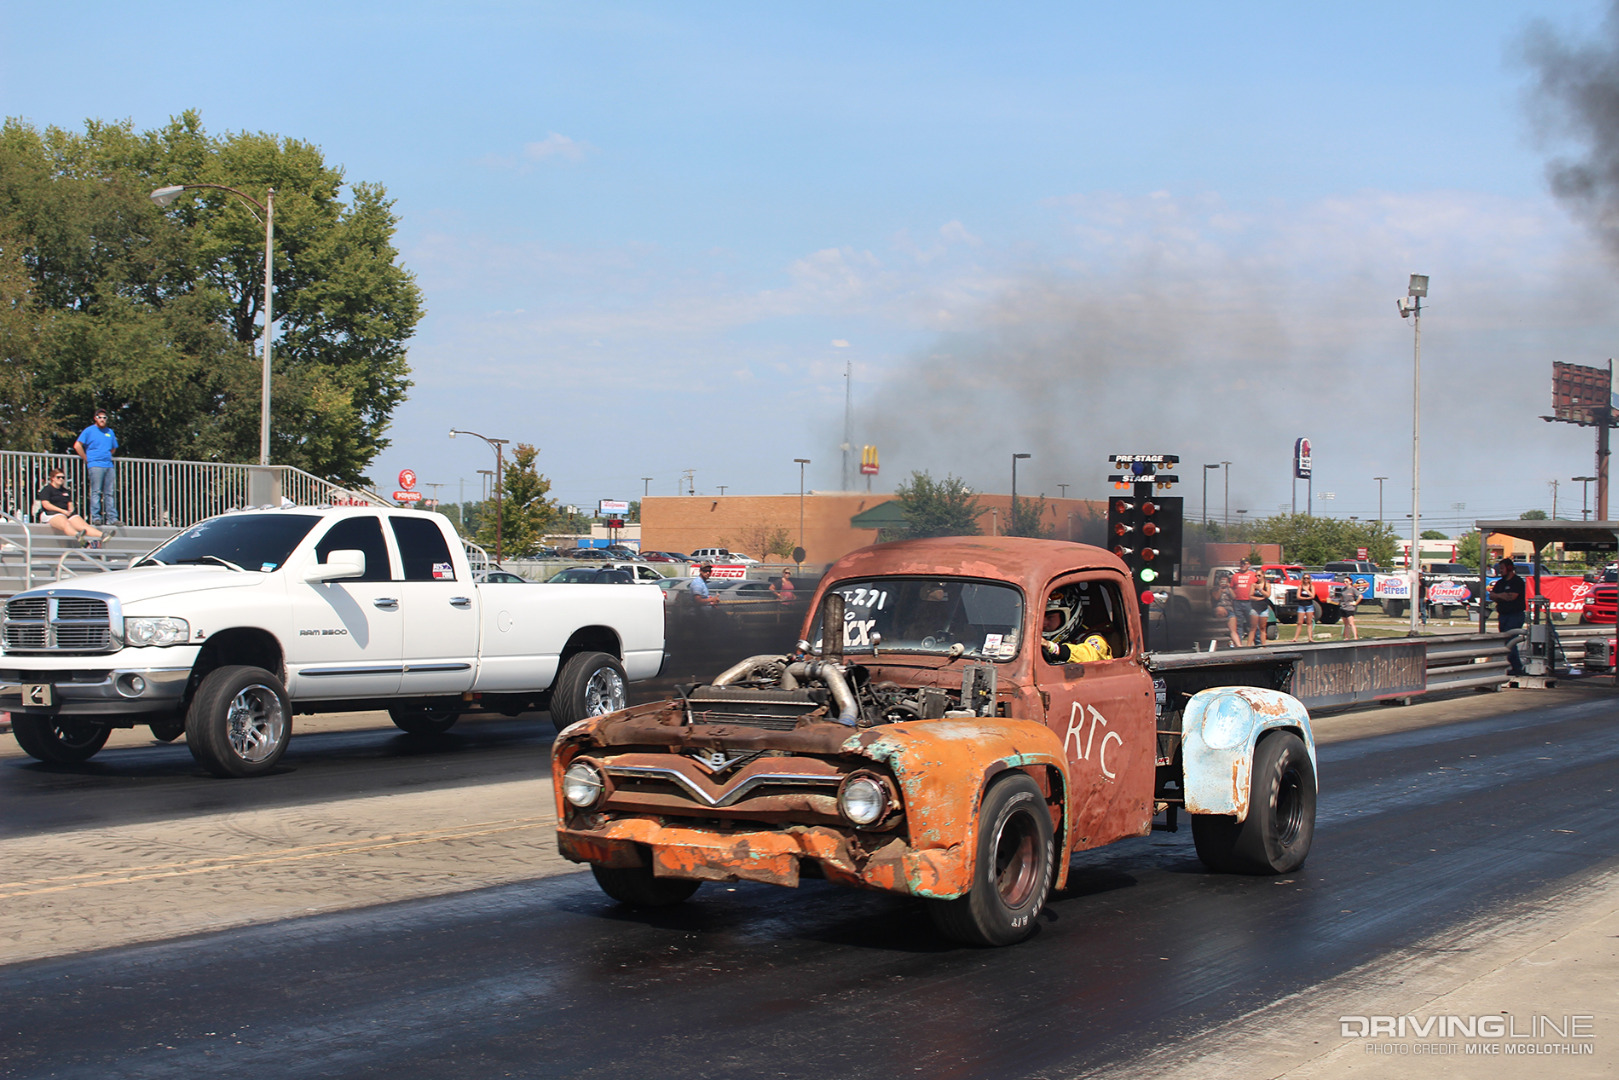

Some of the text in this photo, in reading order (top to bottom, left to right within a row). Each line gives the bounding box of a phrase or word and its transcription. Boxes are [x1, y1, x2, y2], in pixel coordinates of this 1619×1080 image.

[1376, 582, 1387, 592] Jr
[1384, 586, 1408, 594] street
[1430, 585, 1464, 597] SUMMIT
[1063, 701, 1123, 779] RTC
